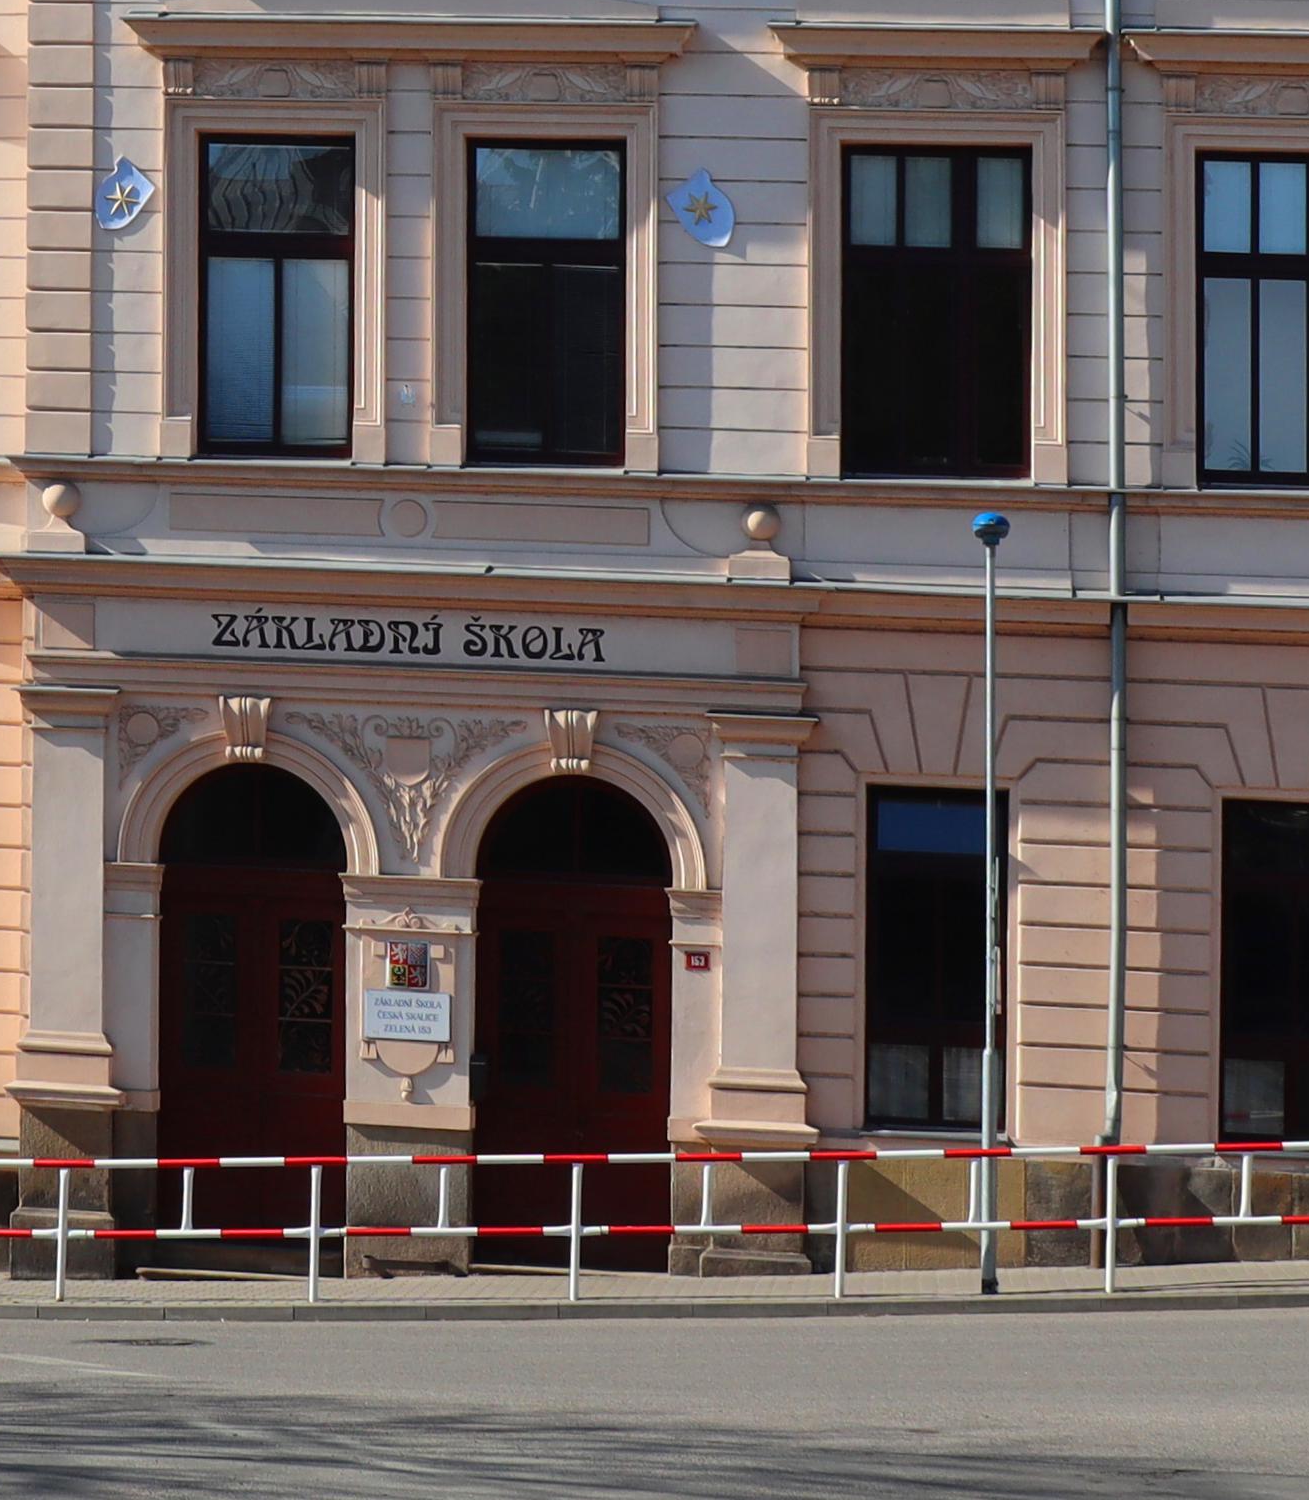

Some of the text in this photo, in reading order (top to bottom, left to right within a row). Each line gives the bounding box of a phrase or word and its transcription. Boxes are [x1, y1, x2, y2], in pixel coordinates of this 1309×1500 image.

[210, 607, 606, 662] ZÁKLADNÍ ŠKOLA
[691, 955, 705, 966] 153
[373, 996, 442, 1009] ZÁKLADNÍ ŠKOLA
[377, 1009, 439, 1022] ČESKÁ SKALICE
[383, 1023, 417, 1034] ZELENÁ
